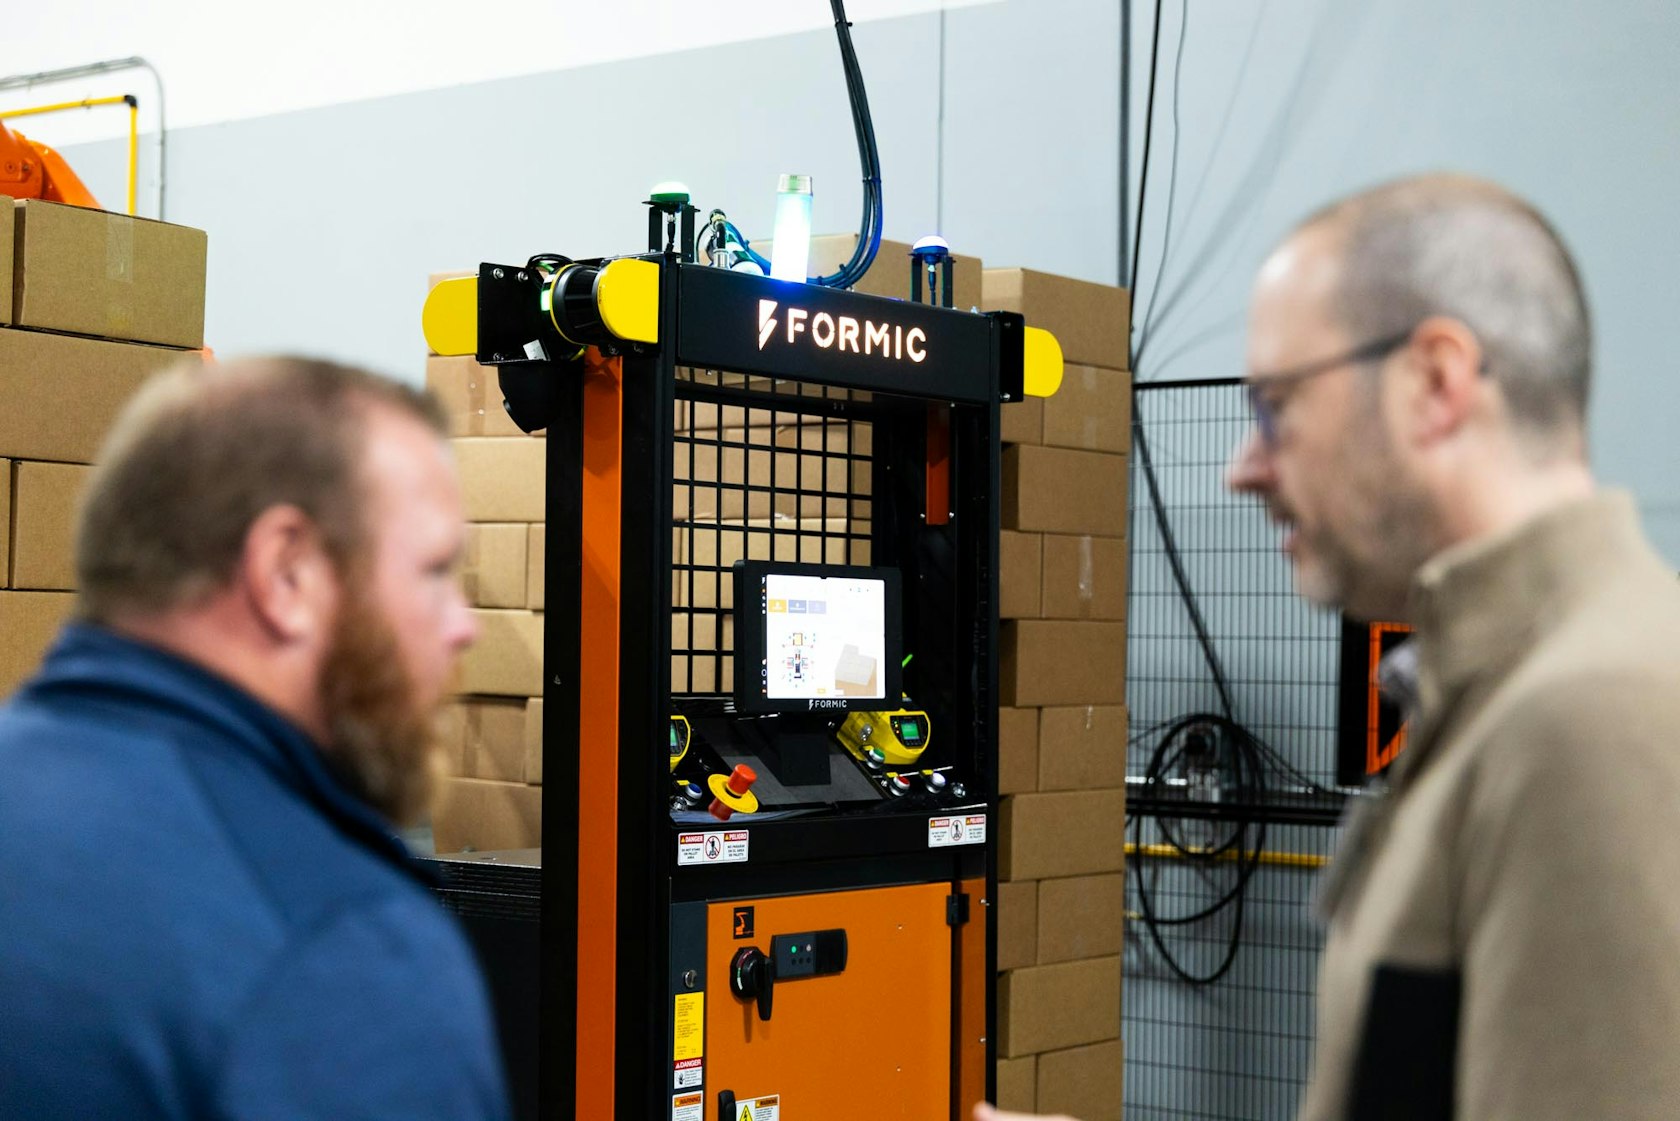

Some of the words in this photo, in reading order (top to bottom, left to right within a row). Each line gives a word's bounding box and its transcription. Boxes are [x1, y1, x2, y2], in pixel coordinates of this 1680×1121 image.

[787, 307, 927, 363] FORMIC
[814, 699, 847, 708] FORMIC
[685, 835, 704, 843] DANGER
[679, 1059, 702, 1068] DANGER
[679, 1096, 701, 1105] WARNING
